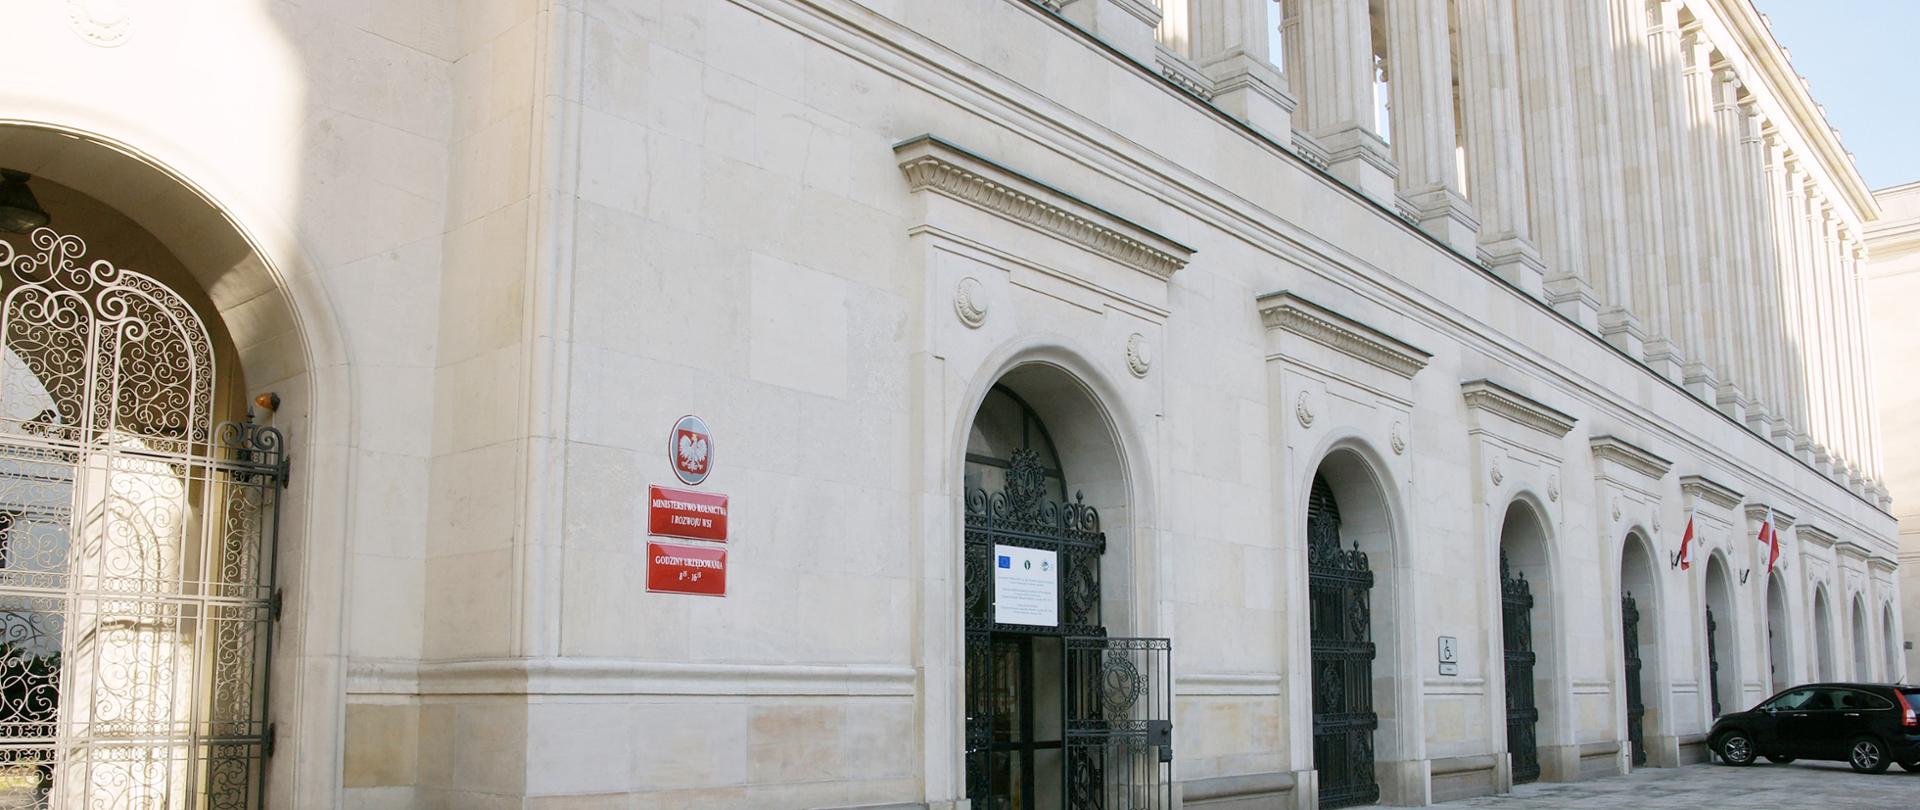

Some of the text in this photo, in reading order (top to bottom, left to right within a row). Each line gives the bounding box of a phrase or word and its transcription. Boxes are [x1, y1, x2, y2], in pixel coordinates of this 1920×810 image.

[652, 499, 697, 511] MINISTERSTWO
[672, 515, 712, 528] I ROZWOJU WSI
[655, 555, 683, 566] GODZINY
